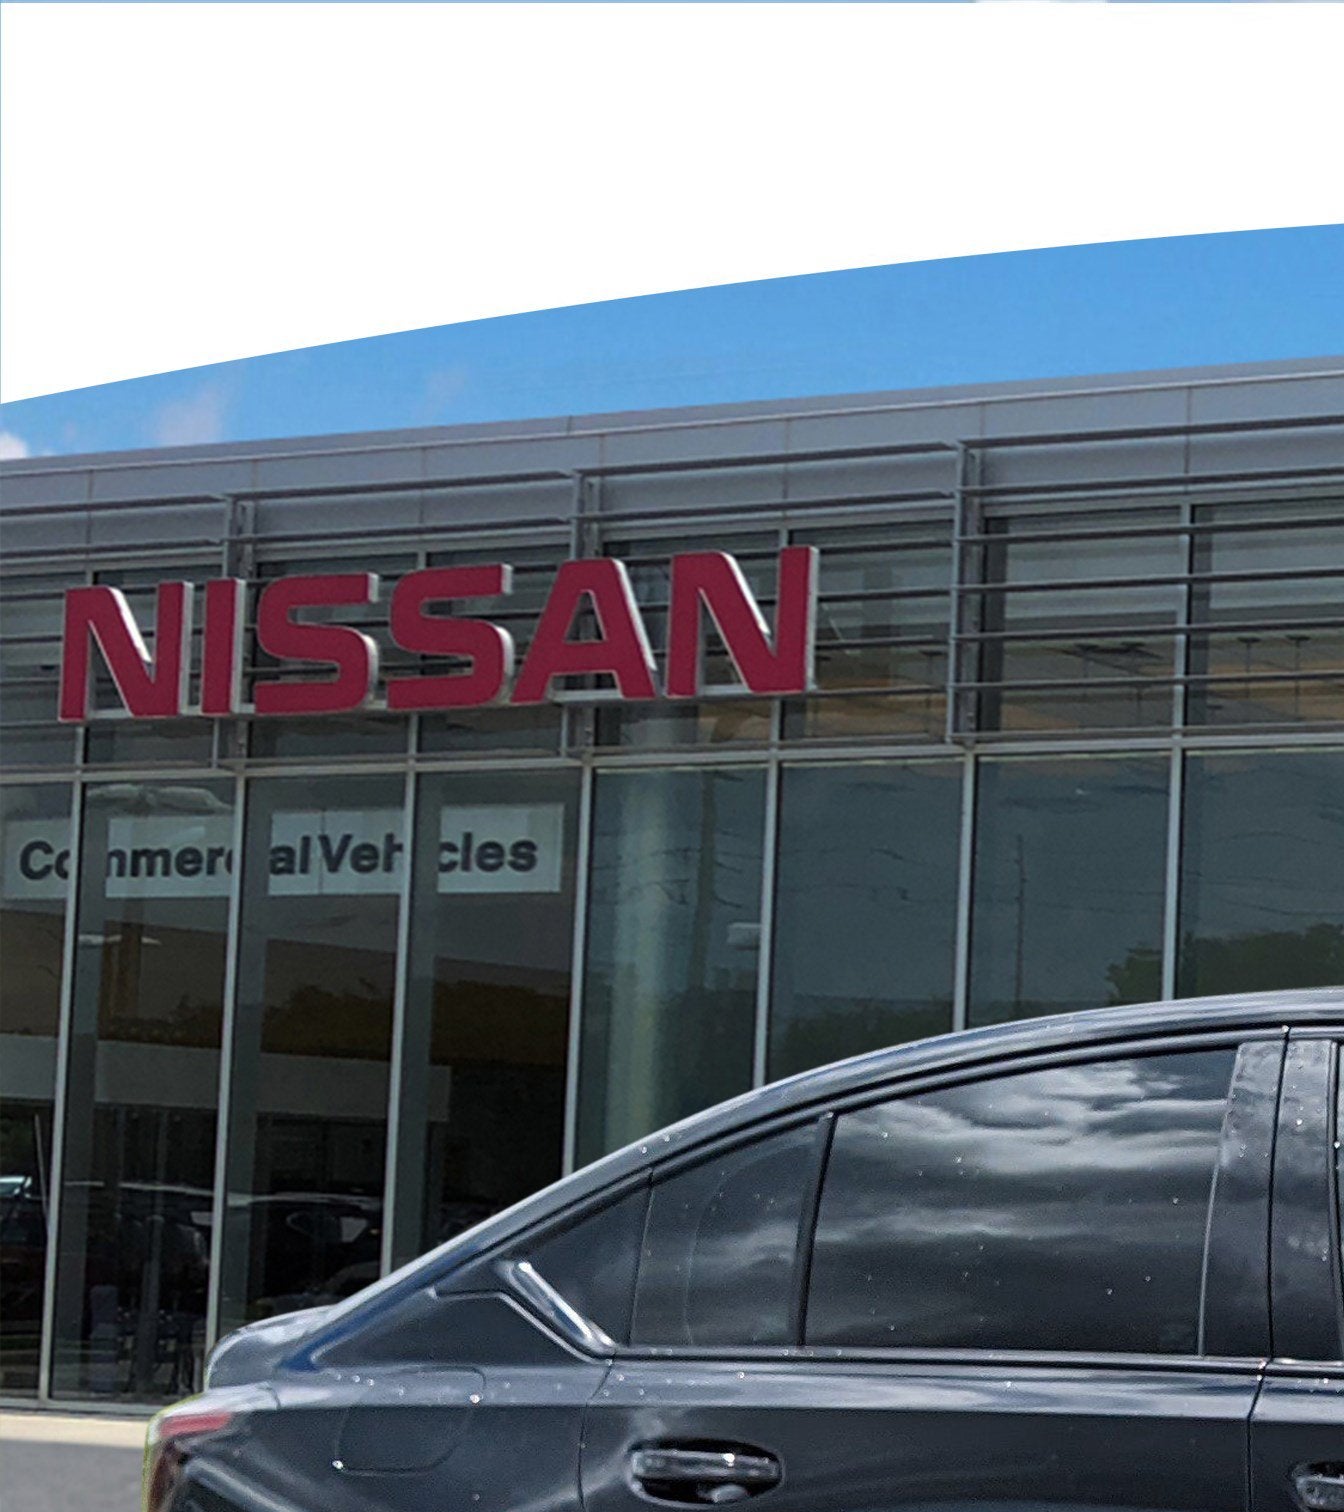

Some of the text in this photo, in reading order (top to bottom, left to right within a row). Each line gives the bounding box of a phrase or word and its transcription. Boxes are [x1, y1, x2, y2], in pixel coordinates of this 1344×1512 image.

[58, 546, 818, 722] NISSAN
[18, 830, 538, 881] Commeral Vehcles
